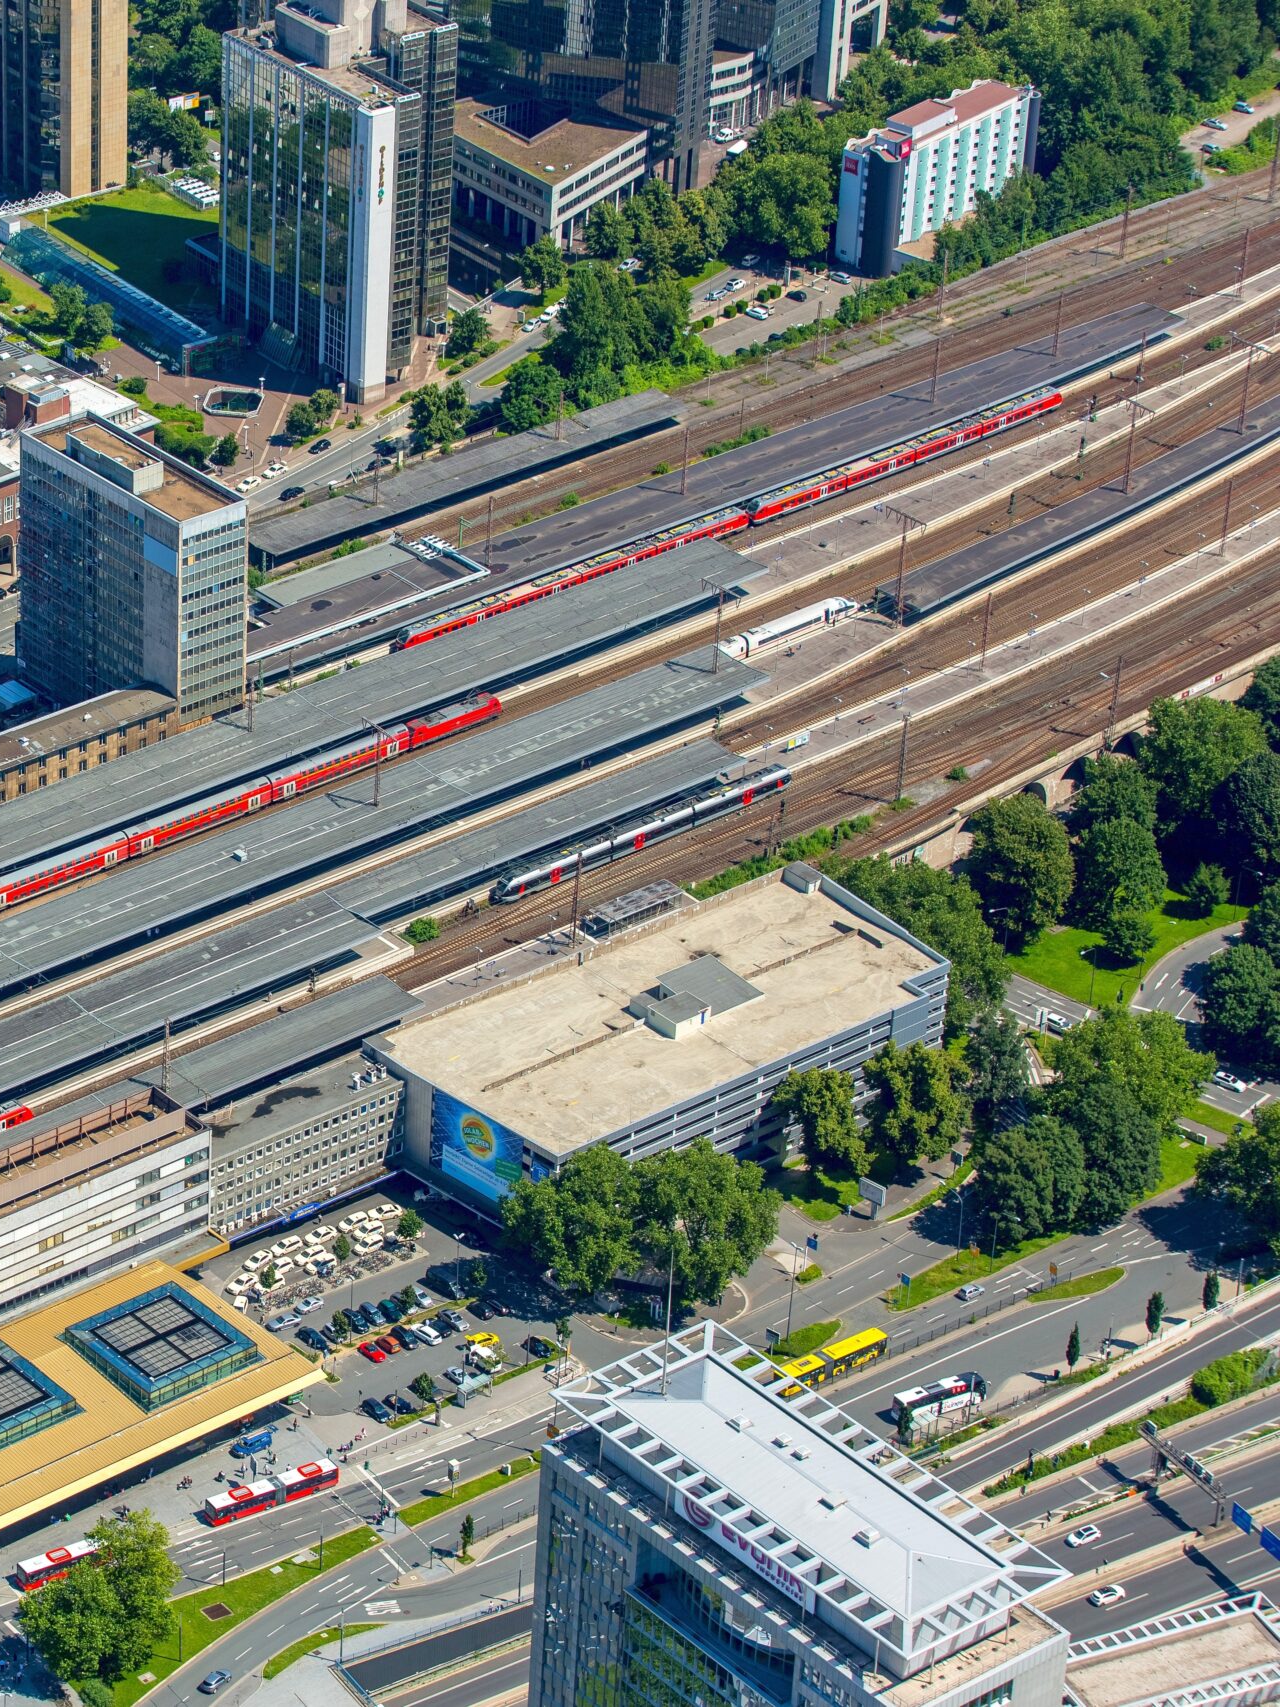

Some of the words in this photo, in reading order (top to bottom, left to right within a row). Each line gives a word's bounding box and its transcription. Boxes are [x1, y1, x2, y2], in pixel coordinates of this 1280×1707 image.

[467, 1136, 490, 1149] WOCHEN
[756, 1562, 803, 1602] INDUSTRIES
[363, 1600, 401, 1615] BUS
